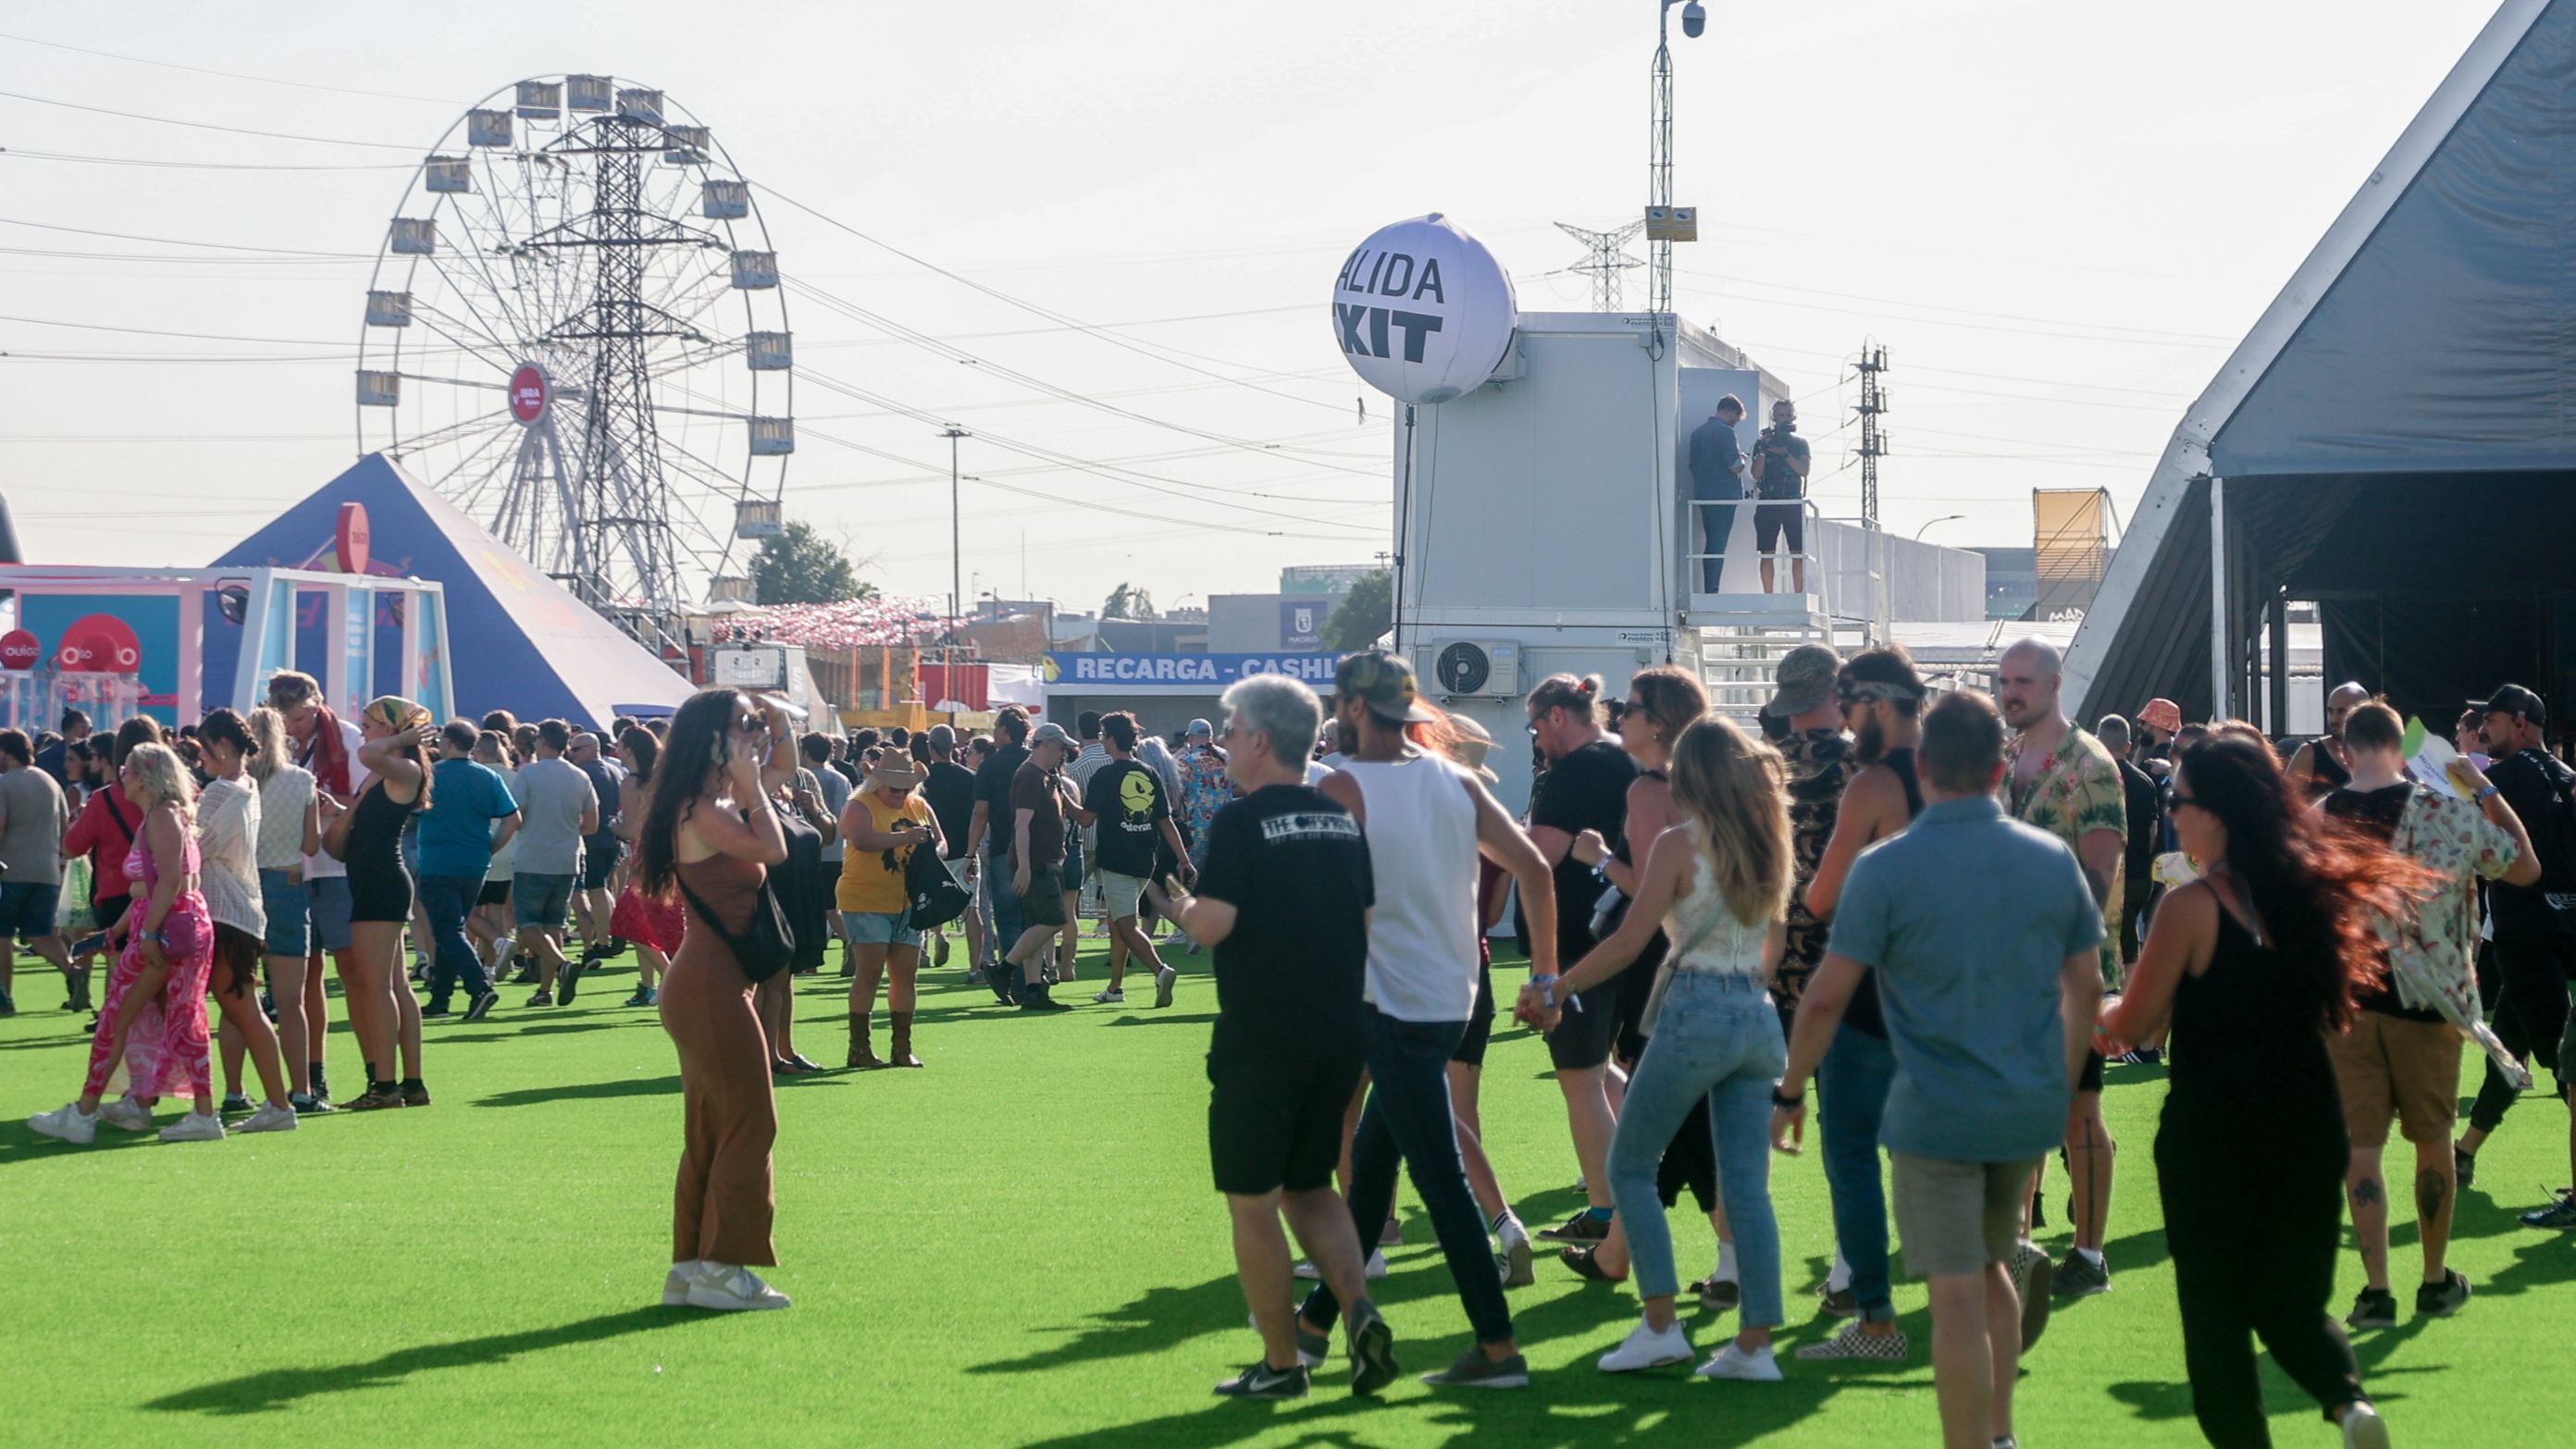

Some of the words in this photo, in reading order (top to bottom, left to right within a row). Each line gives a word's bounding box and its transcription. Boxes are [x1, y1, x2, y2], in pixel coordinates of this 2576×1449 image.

[1335, 248, 1444, 304] ALIDA
[1332, 303, 1443, 364] XIT
[1076, 658, 1218, 680] RECARGA
[1241, 658, 1336, 680] CASHL
[1264, 819, 1292, 837] THE
